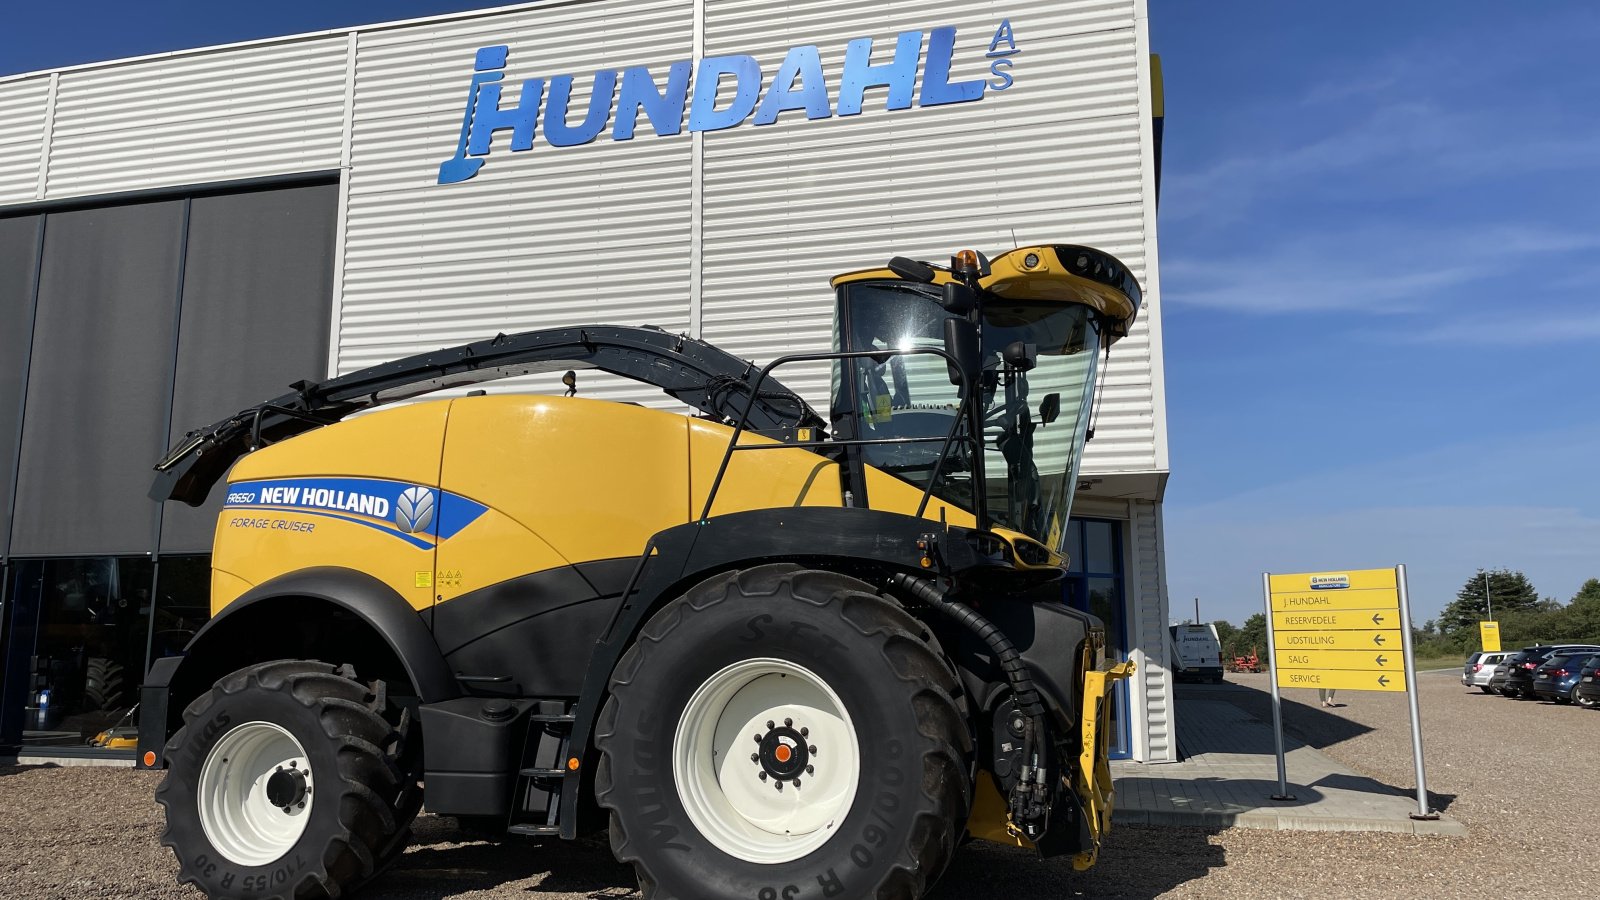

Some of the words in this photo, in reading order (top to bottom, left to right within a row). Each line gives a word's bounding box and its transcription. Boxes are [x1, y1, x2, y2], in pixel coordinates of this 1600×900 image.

[226, 492, 255, 504] FR650
[259, 486, 301, 505] NEW
[301, 487, 390, 518] HOLLAND
[229, 518, 270, 529] FORAGE
[271, 519, 316, 533] CRUISER
[1289, 596, 1331, 606] HUNDAHL
[1285, 616, 1337, 625] RESERVEDELE
[1286, 636, 1335, 645] UDSTILLING
[1288, 655, 1309, 664] SALG
[1289, 674, 1321, 684] SERVICE
[194, 853, 217, 878] 30
[242, 854, 307, 892] 710/55
[220, 871, 237, 890] R
[816, 867, 846, 899] R
